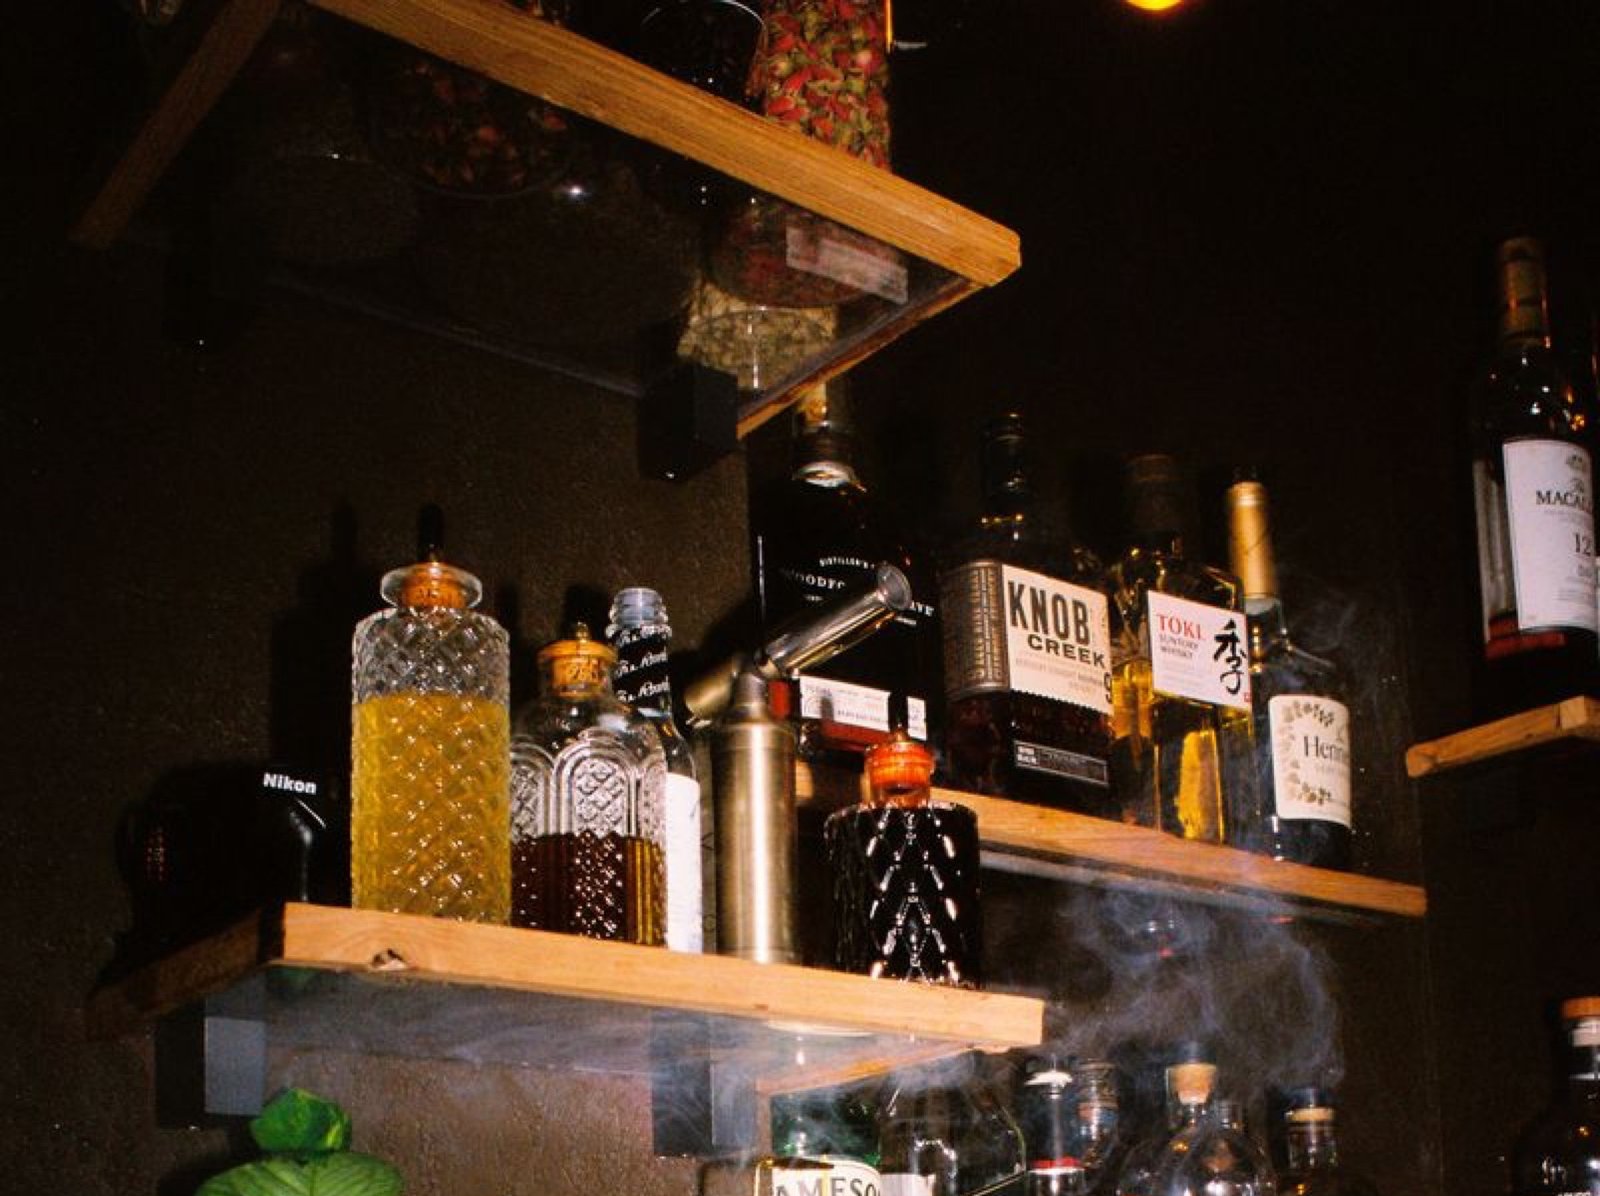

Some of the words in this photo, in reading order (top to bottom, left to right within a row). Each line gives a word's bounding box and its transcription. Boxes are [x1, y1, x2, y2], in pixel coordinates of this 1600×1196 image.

[1574, 532, 1591, 556] 12
[1008, 581, 1090, 646] KNOB
[1157, 613, 1201, 640] TOKI
[1028, 634, 1105, 669] CREEK
[263, 772, 317, 795] Nikon
